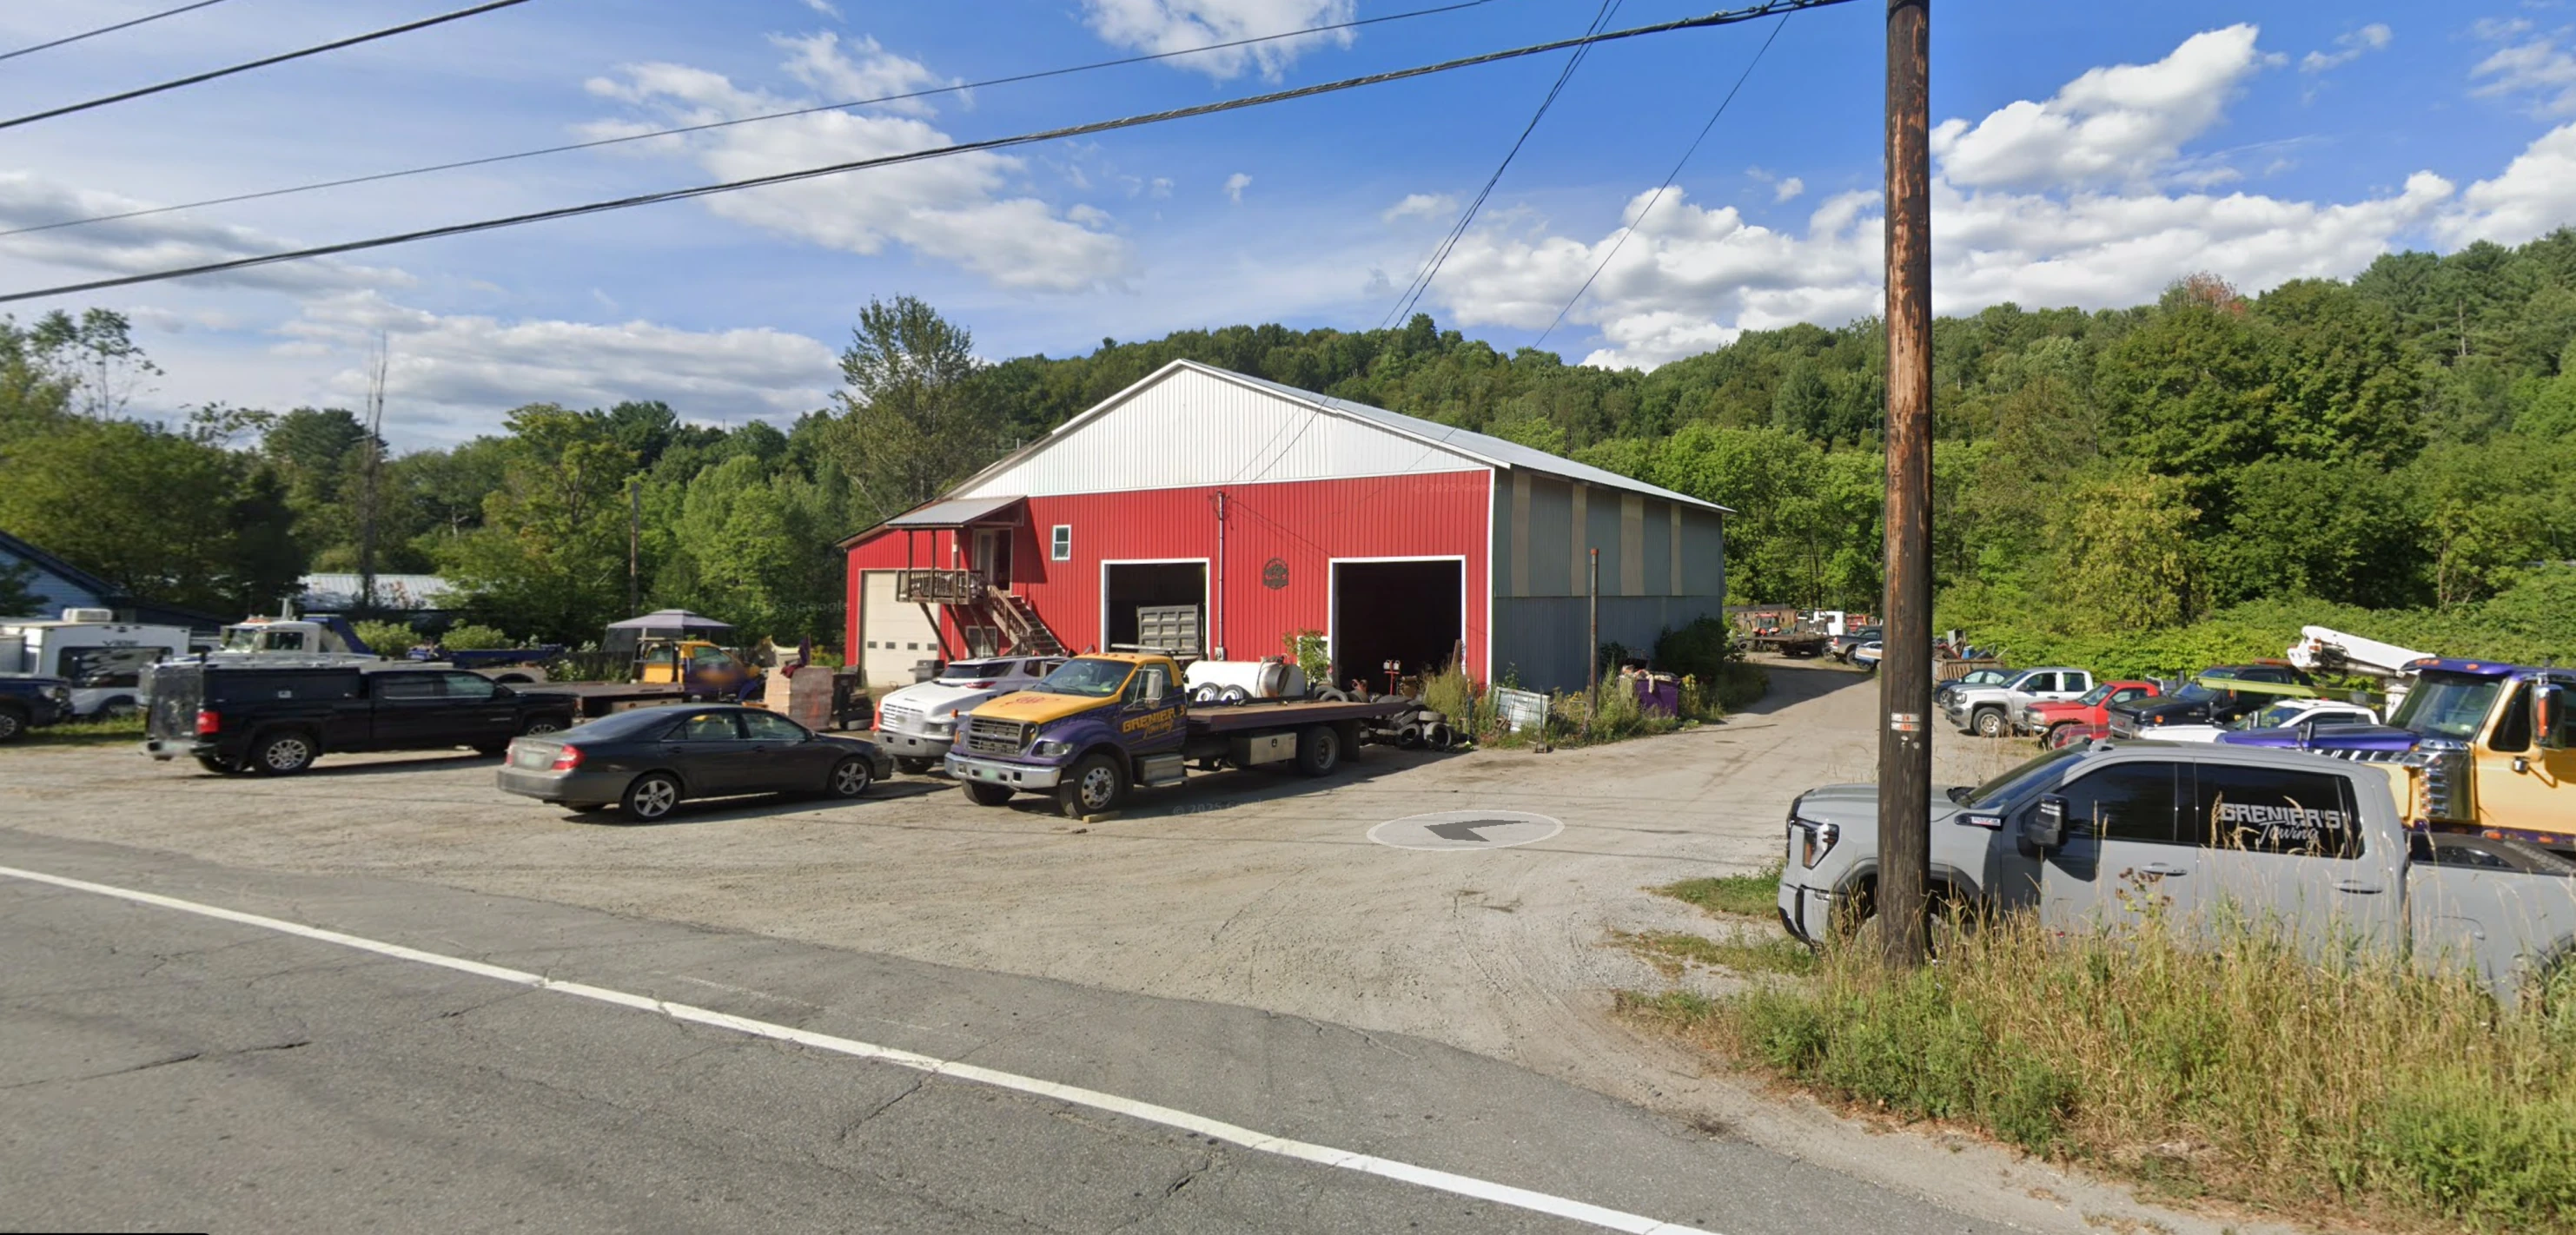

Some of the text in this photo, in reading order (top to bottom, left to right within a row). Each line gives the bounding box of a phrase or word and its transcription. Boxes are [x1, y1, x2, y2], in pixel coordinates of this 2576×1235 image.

[1122, 703, 1187, 734] GRENIERS
[2221, 802, 2341, 829] GRENIER'S
[2258, 820, 2320, 845] Towing
